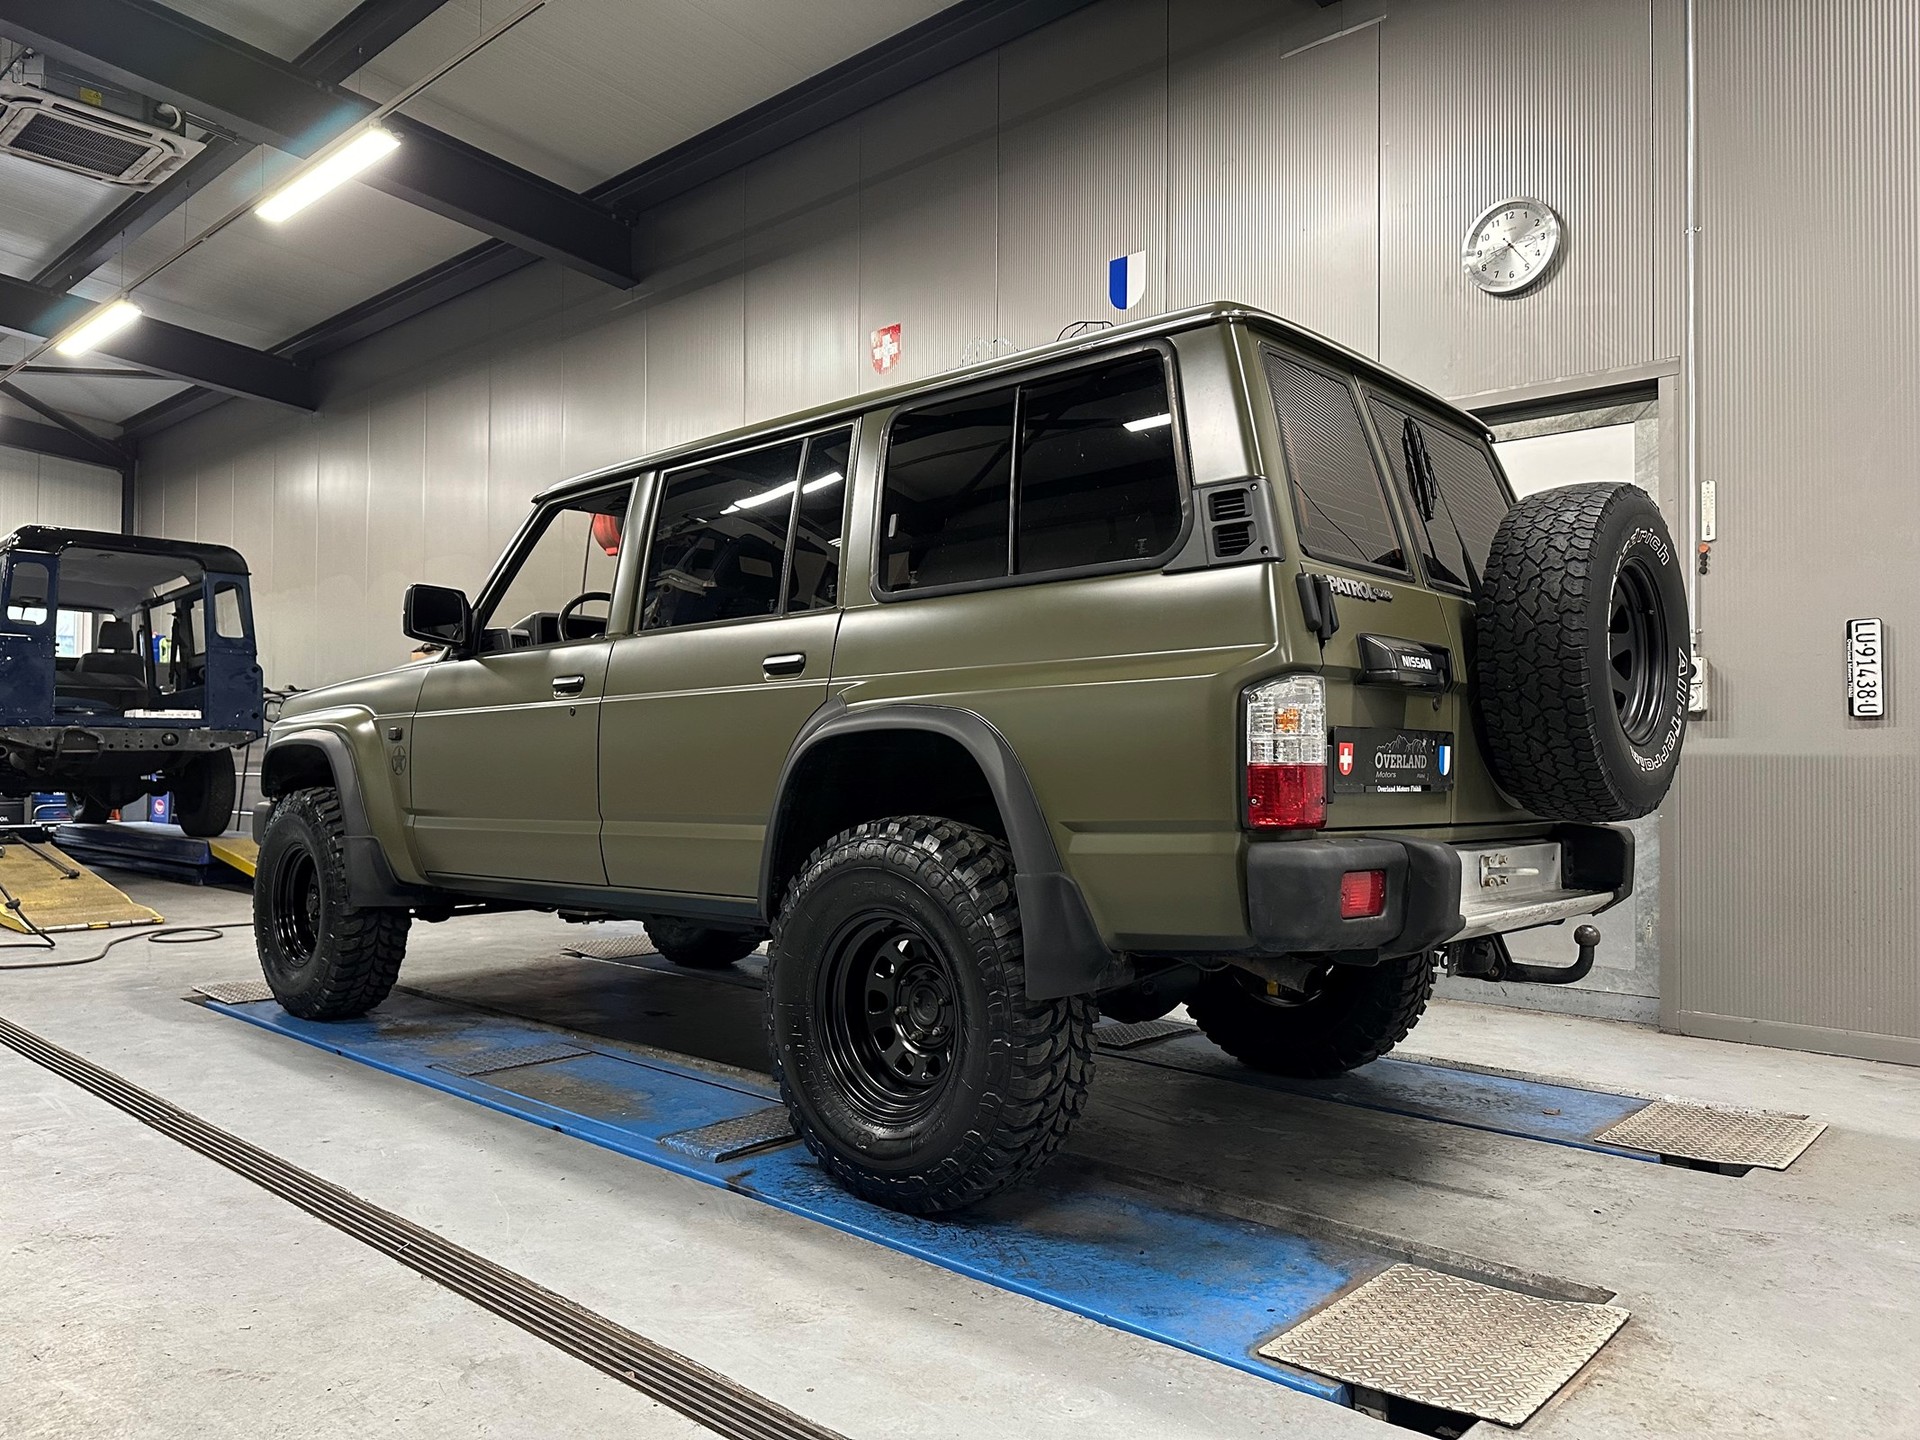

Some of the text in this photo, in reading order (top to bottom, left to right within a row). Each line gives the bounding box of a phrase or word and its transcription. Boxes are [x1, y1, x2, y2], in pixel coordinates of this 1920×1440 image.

[1504, 211, 1515, 220] 12
[1523, 211, 1528, 219] 1
[1491, 219, 1500, 228] 11
[1534, 218, 1540, 227] 2
[1480, 233, 1490, 242] 10
[1540, 232, 1546, 240] 3
[1476, 249, 1483, 258] 9
[1481, 264, 1487, 272] 8
[1524, 263, 1531, 271] 5
[1494, 270, 1500, 278] 7
[1508, 270, 1515, 278] 6
[1326, 574, 1377, 600] PATROL
[1401, 655, 1432, 671] NISSAN
[1374, 751, 1428, 769] OVERLAND
[1375, 770, 1397, 779] Motors
